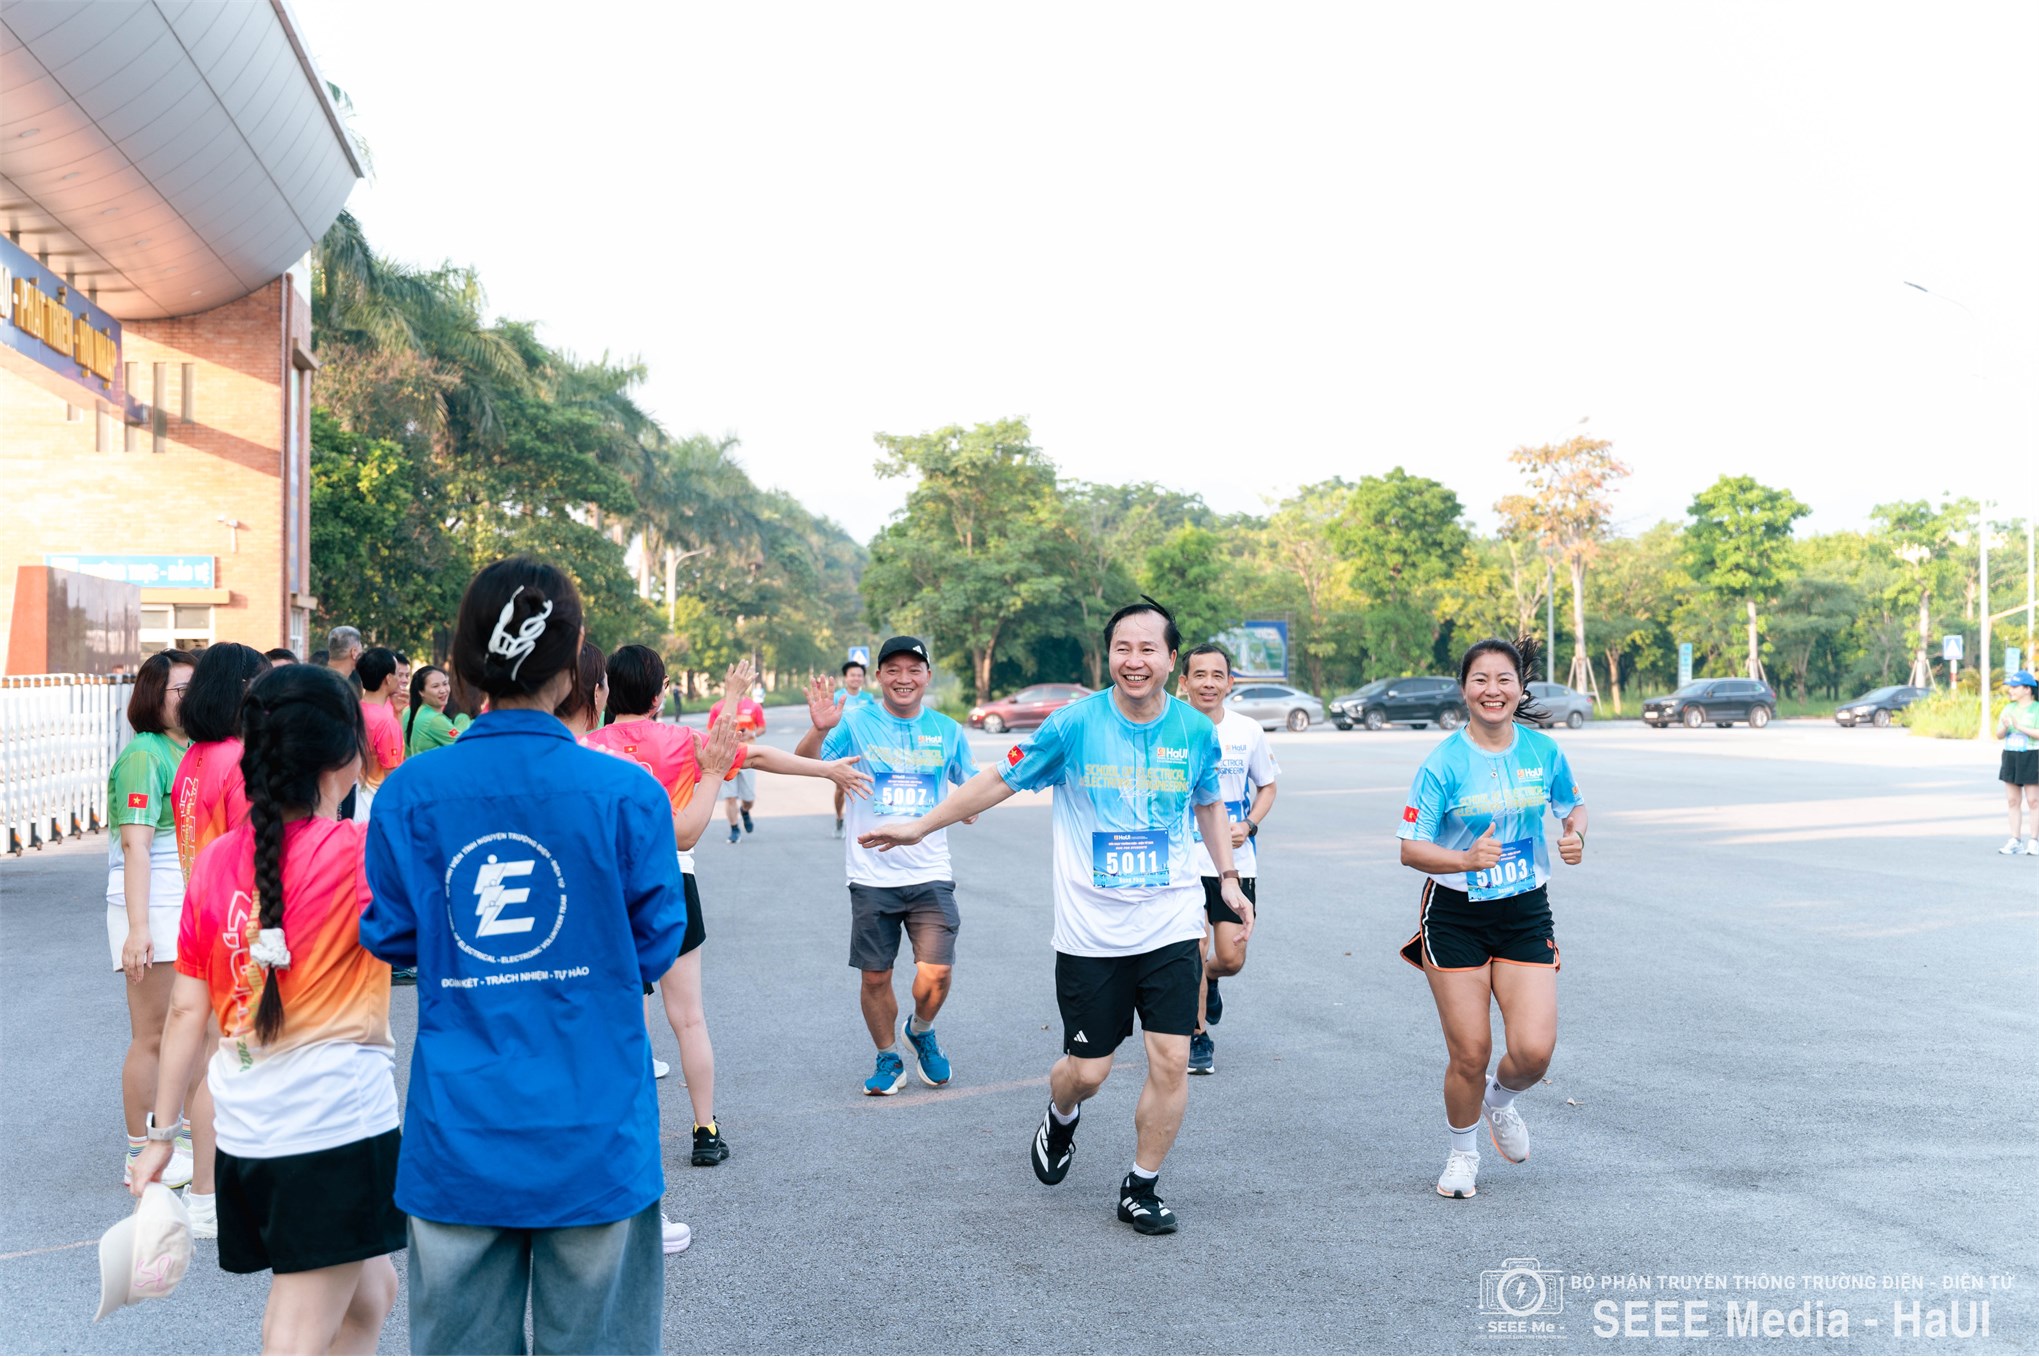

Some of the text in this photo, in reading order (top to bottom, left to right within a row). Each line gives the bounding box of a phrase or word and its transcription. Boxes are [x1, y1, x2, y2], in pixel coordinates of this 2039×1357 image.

[1166, 747, 1188, 759] HaUI
[1085, 764, 1120, 777] SCHOOL
[1136, 766, 1187, 781] ELECTRICAL
[1525, 767, 1543, 777] HaUI
[882, 786, 927, 805] 5007
[1106, 850, 1157, 874] 5011
[1476, 858, 1528, 887] 5003
[485, 973, 519, 986] TRÁCH
[520, 970, 549, 982] NHIỆM
[554, 969, 568, 981] TỰ
[568, 966, 590, 978] HÀO
